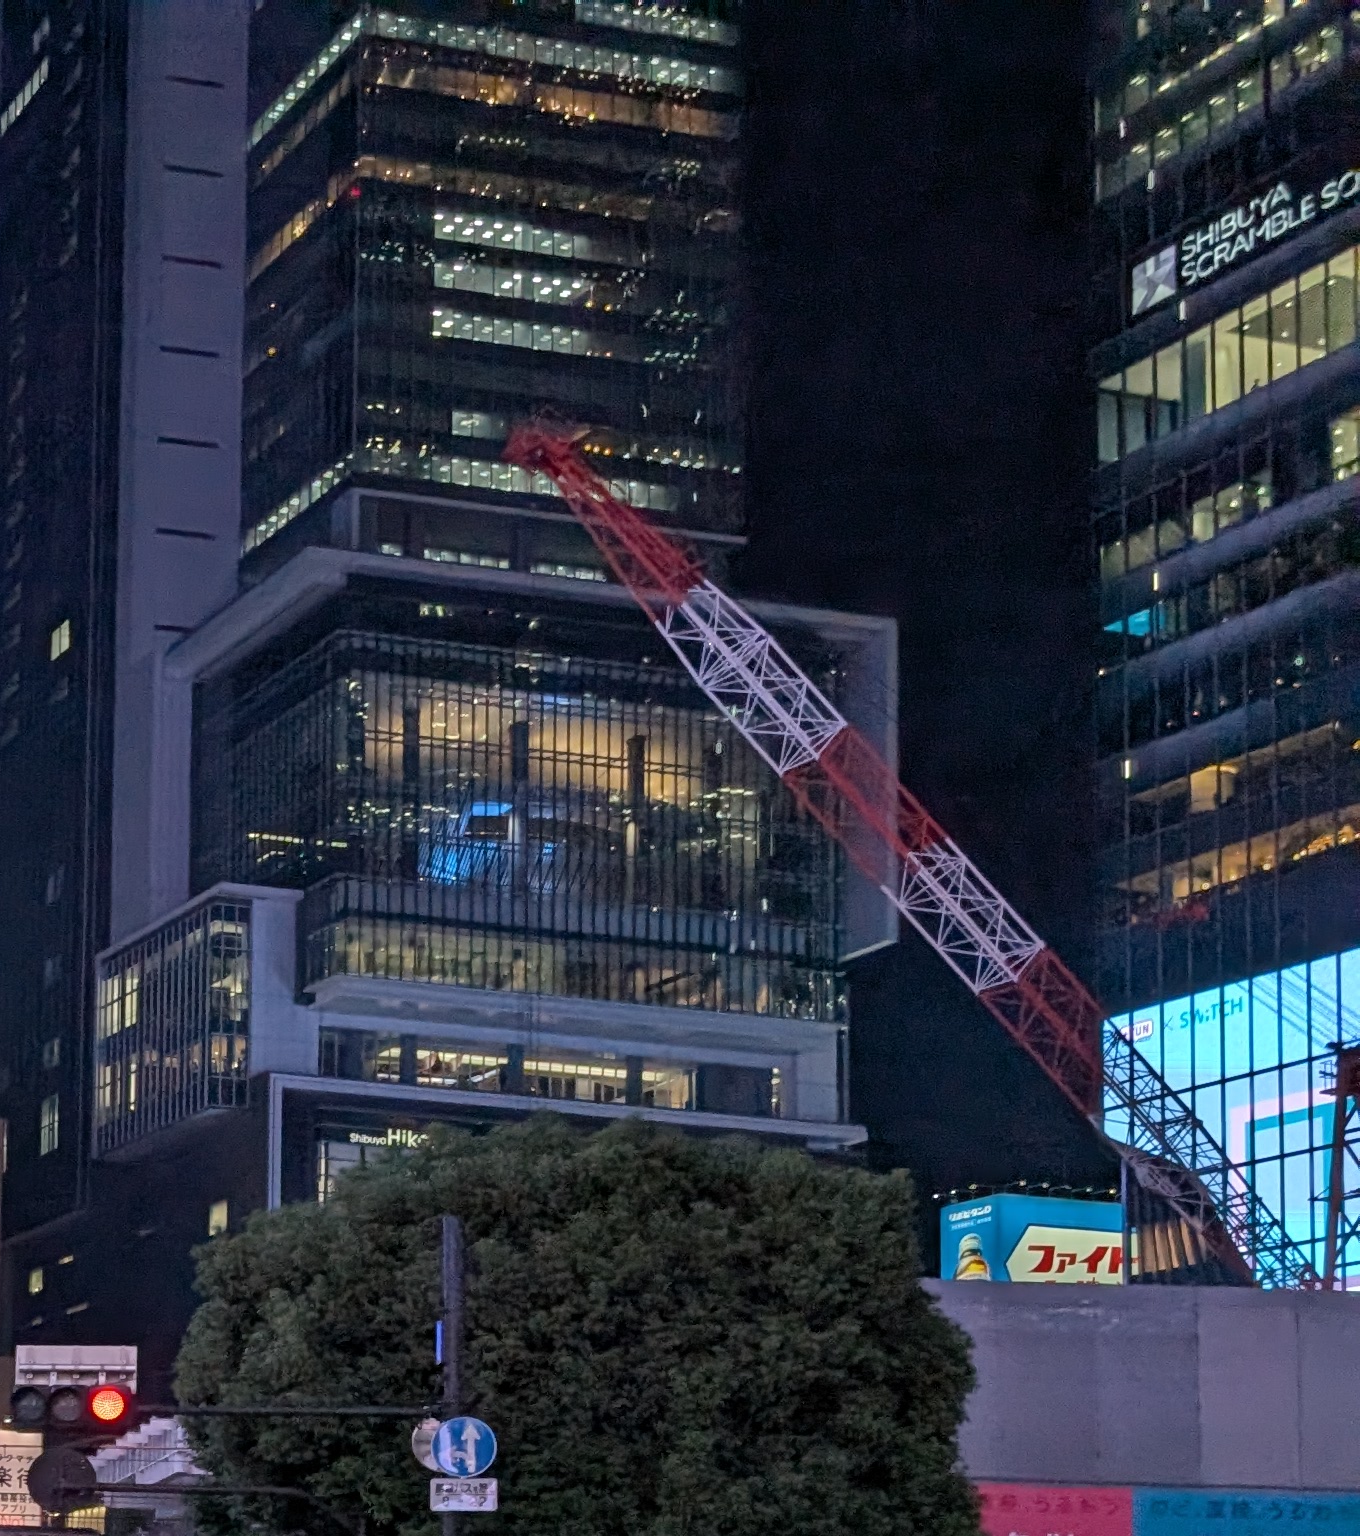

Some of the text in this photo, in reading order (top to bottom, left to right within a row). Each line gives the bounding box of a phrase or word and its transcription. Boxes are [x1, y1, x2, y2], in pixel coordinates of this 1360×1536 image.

[1181, 181, 1292, 262] SHIBUYA
[1181, 193, 1316, 286] SCRAMBLE
[0, 1503, 27, 1514] アプリ
